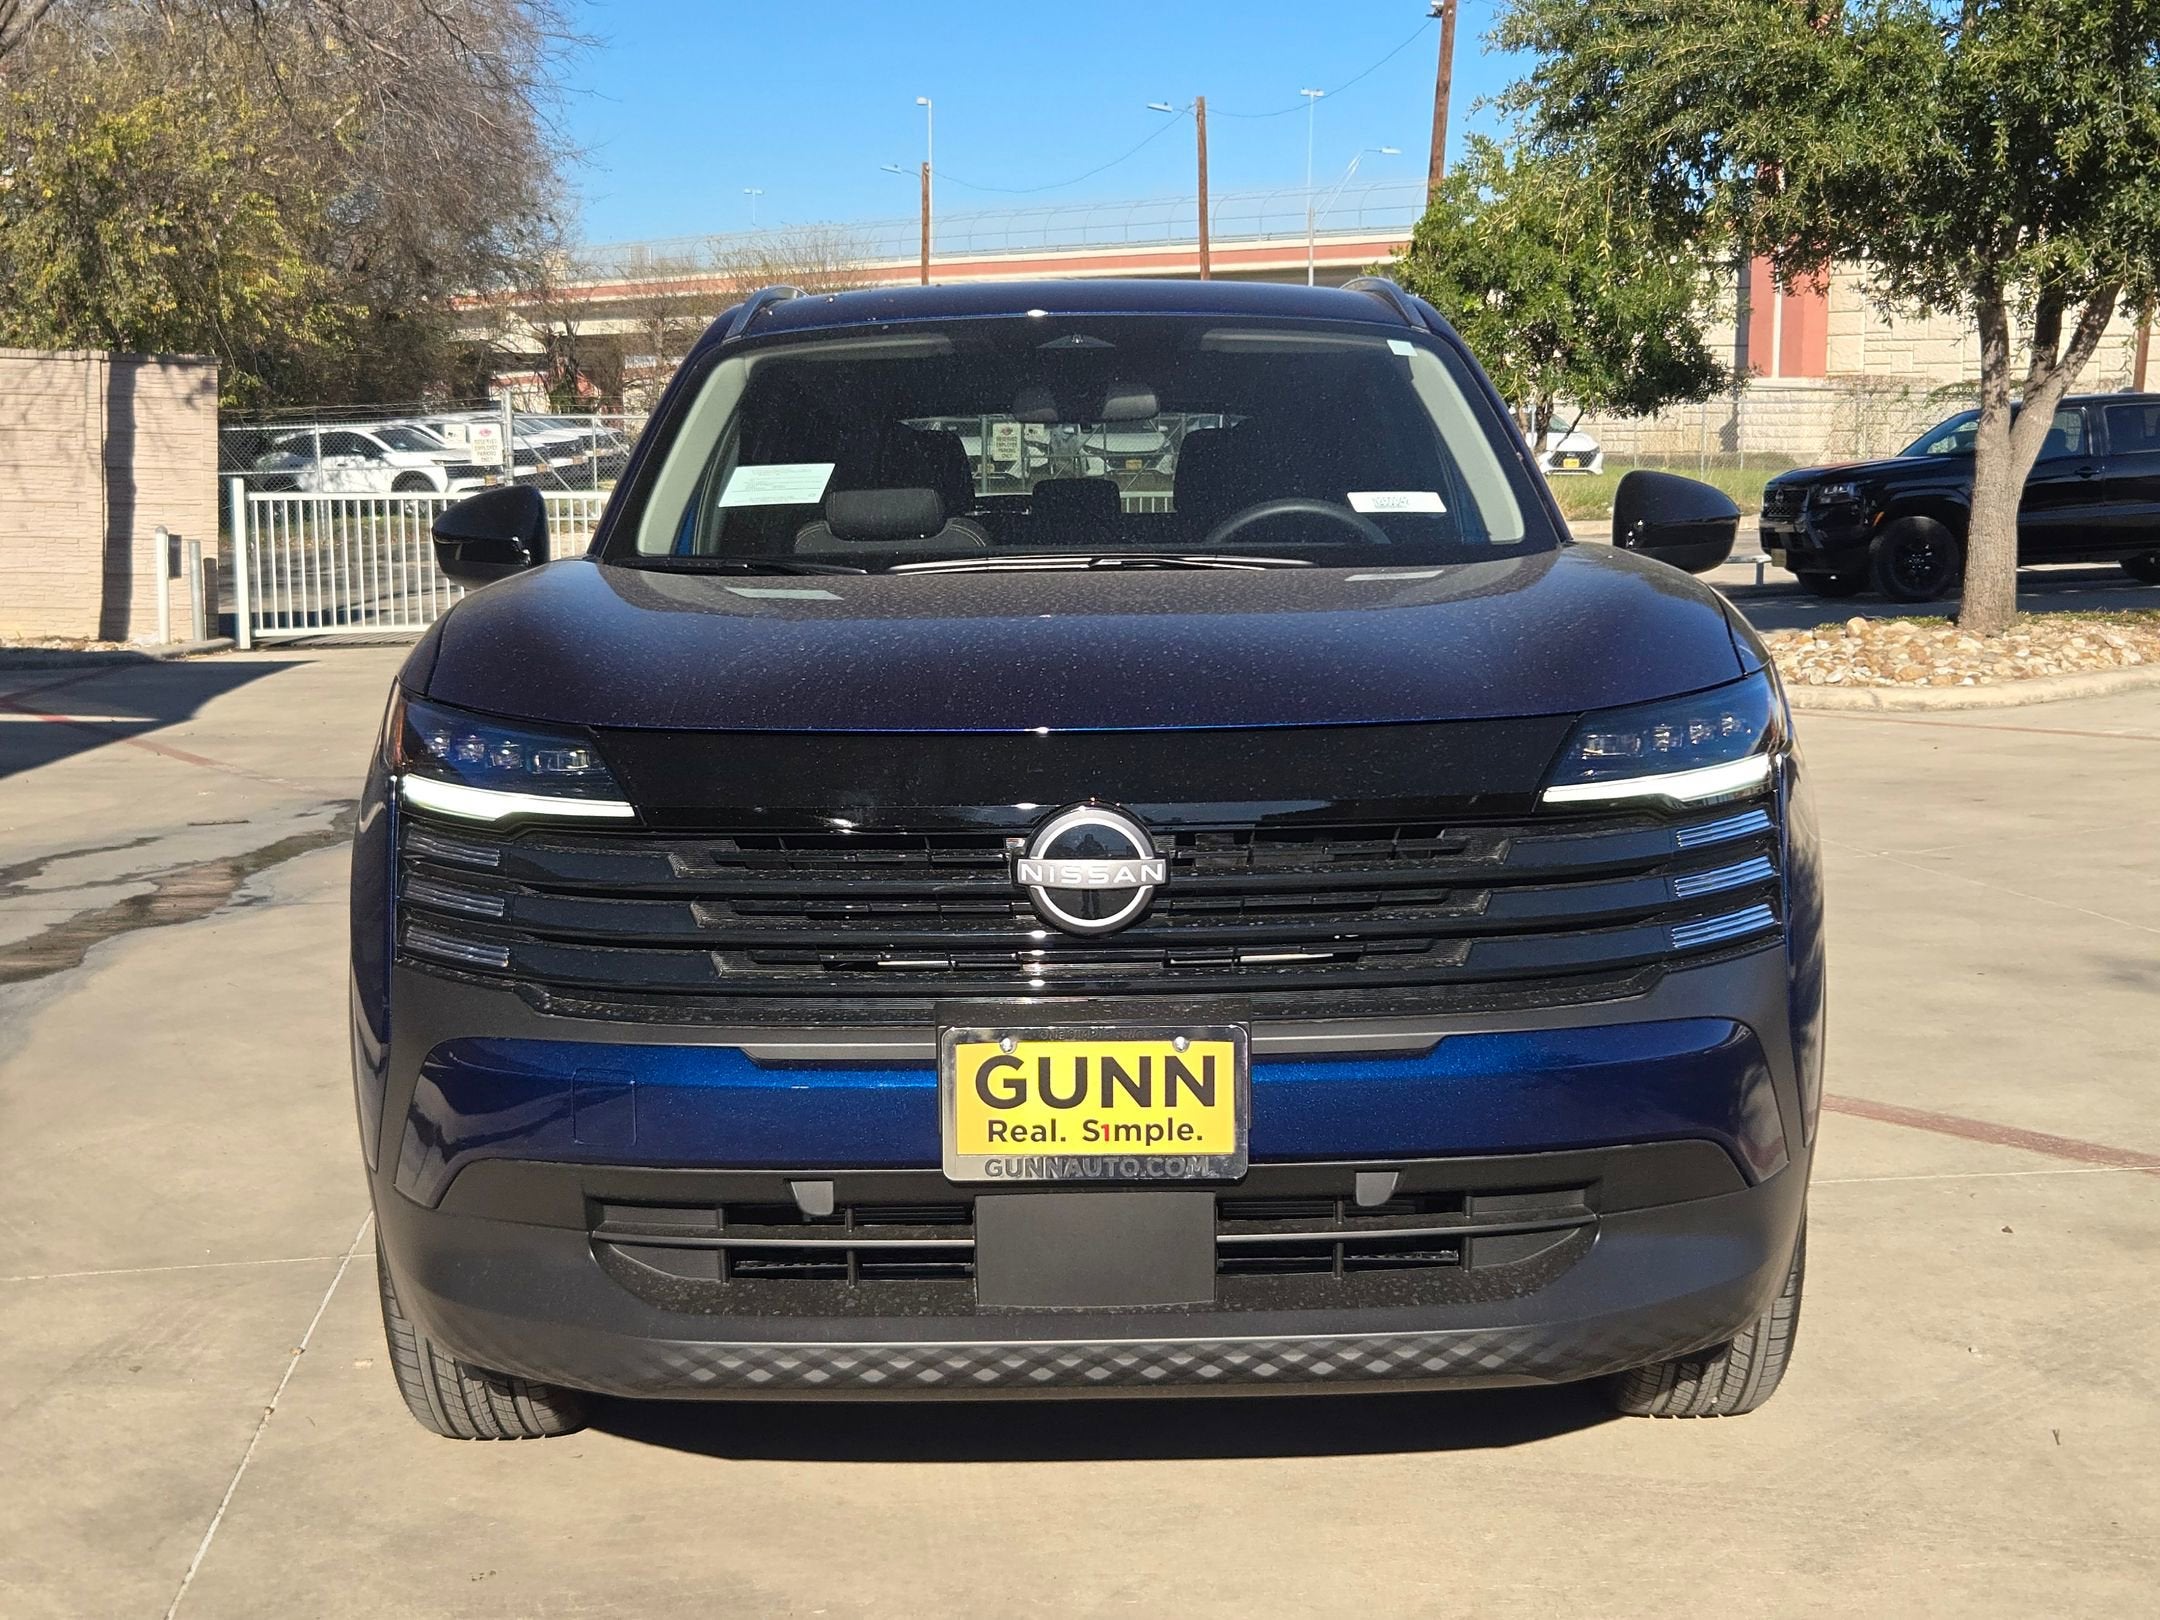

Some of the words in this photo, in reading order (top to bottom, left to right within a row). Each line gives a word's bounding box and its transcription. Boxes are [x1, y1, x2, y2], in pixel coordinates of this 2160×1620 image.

[1021, 863, 1163, 884] NISSAN
[975, 1054, 1215, 1109] GUNN
[987, 1119, 1066, 1142] Real.
[985, 1157, 1209, 1179] GUNNAUTO.COM
